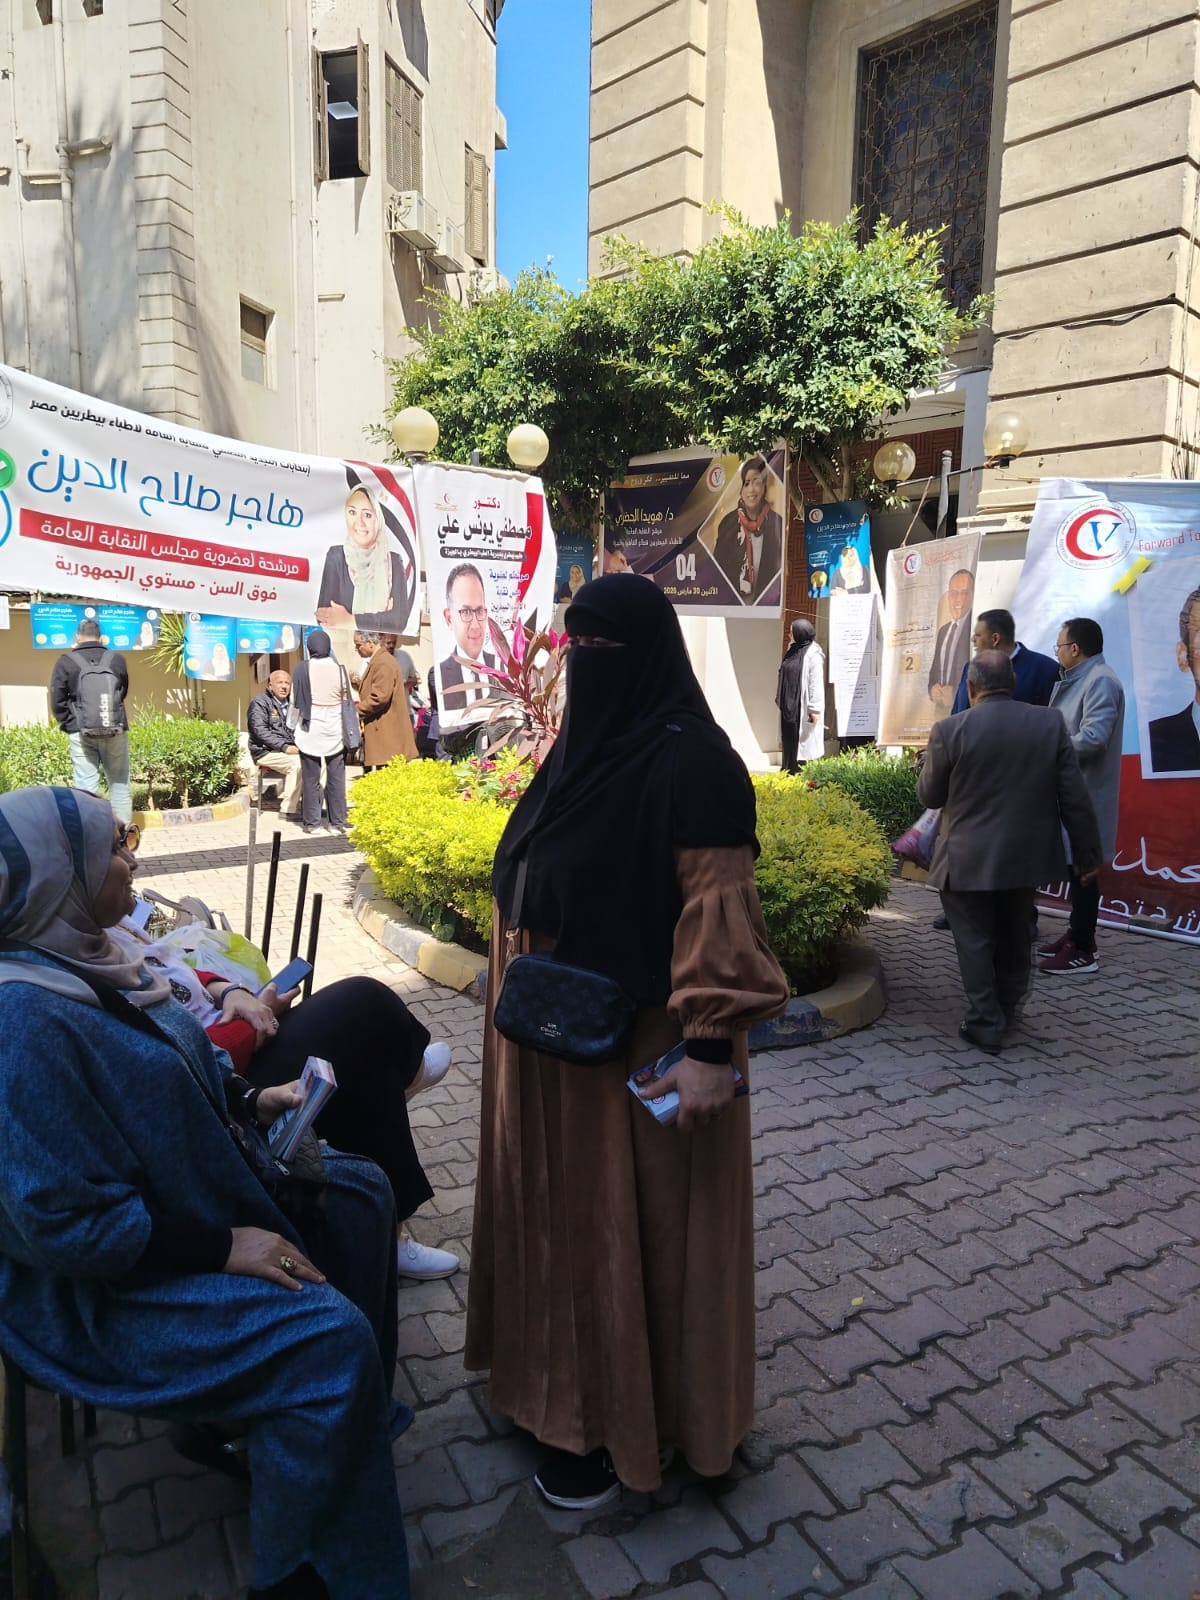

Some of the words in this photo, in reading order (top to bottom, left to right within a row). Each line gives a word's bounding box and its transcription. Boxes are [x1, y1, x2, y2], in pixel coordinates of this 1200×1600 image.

[29, 399, 58, 412] مصر
[60, 405, 106, 427] بيطريين
[27, 449, 128, 503] الدين
[139, 471, 221, 517] صلاح
[225, 492, 304, 530] هاجر
[41, 520, 95, 543] العامة
[437, 513, 460, 545] علي
[463, 514, 495, 544] يونس
[98, 530, 148, 550] النقابة
[151, 540, 199, 561] مجلس
[1139, 531, 1184, 552] Forward
[203, 547, 255, 568] لعضوية
[258, 556, 299, 576] مرشحة
[675, 553, 697, 581] 04
[55, 555, 135, 583] الجمهورية
[139, 571, 196, 592] مستوي
[209, 581, 244, 597] السن
[247, 583, 278, 602] فوق
[905, 656, 914, 671] 2
